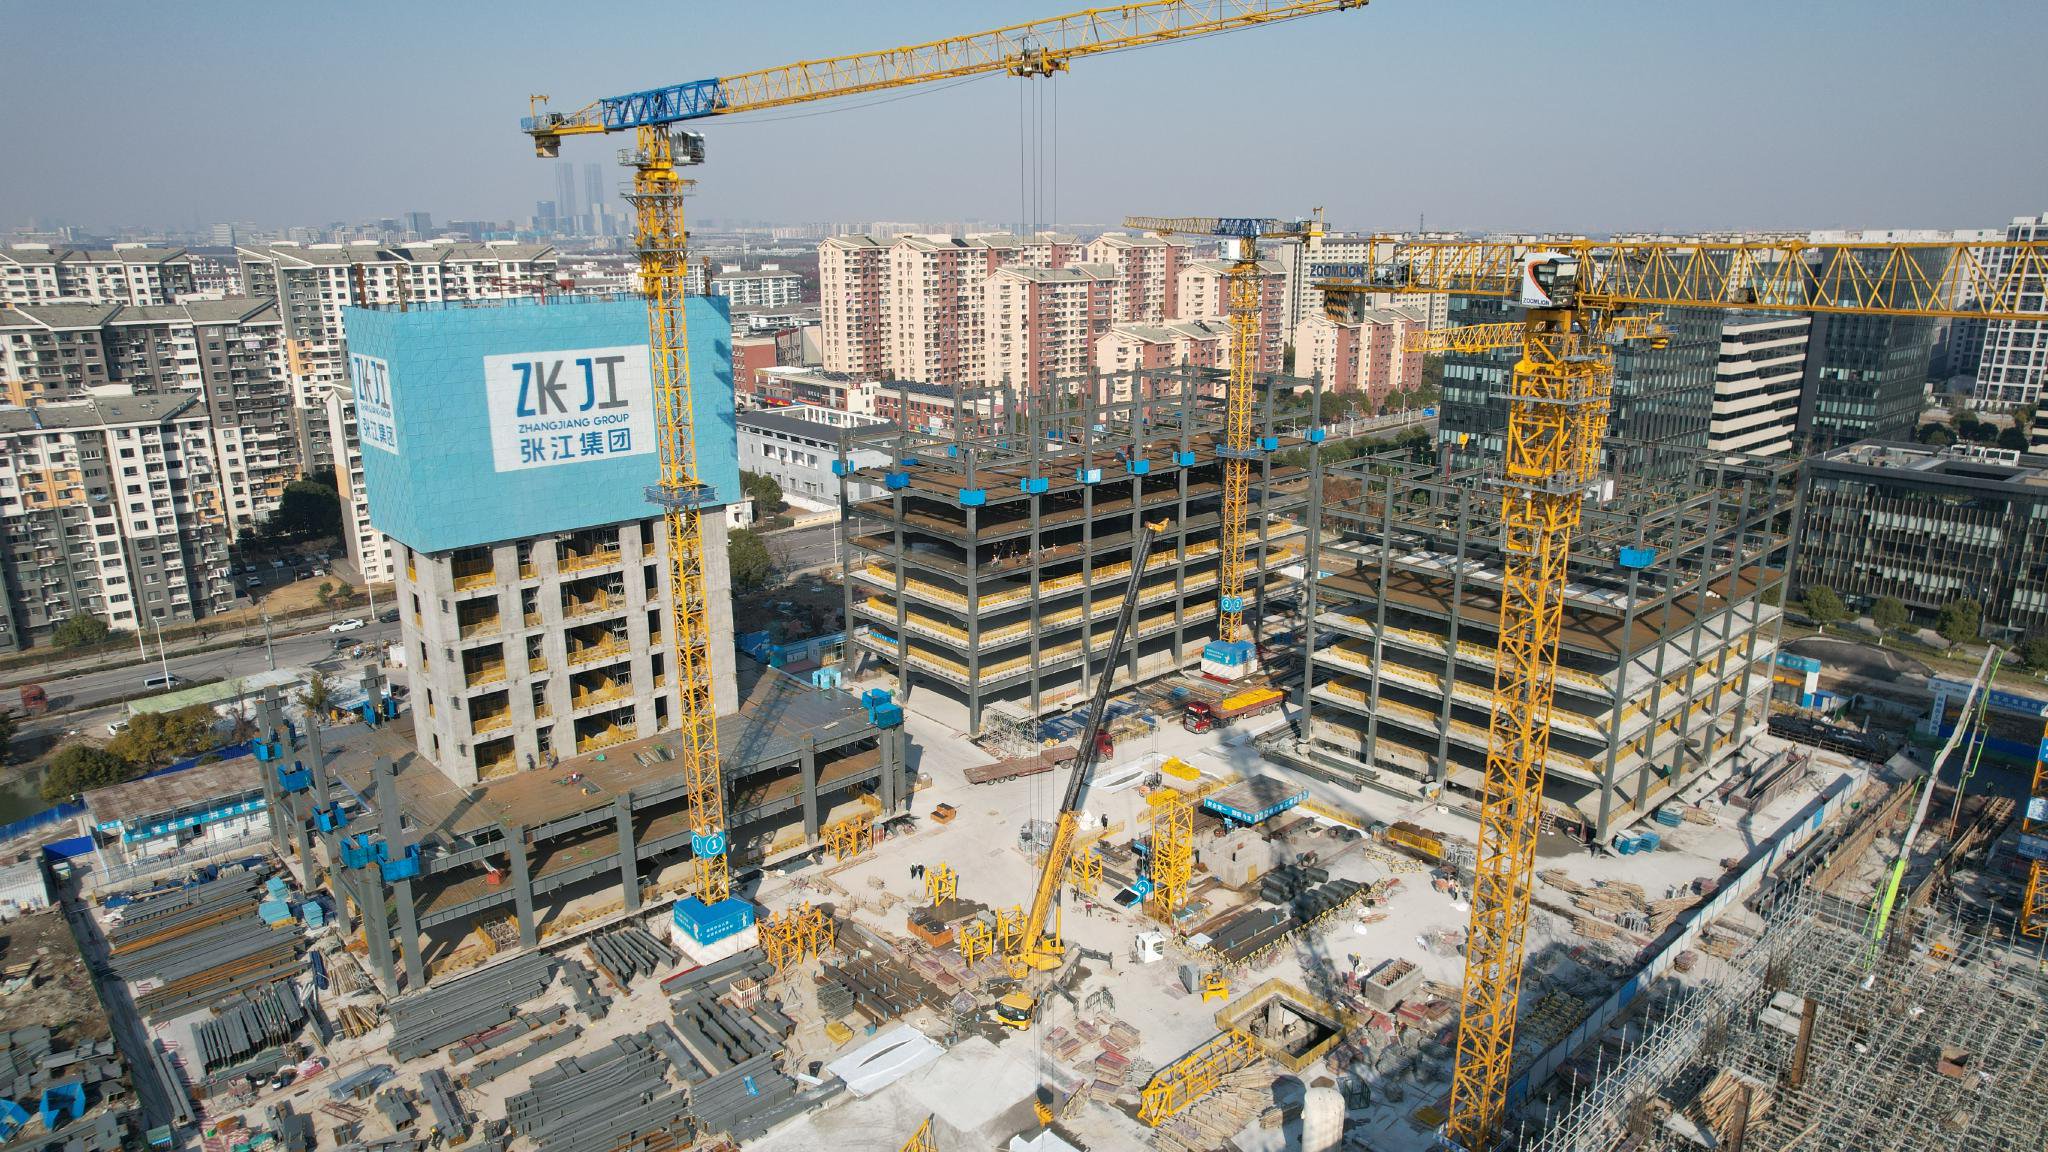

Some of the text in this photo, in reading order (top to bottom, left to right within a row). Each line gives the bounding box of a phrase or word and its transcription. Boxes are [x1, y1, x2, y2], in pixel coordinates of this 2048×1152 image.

[1310, 265, 1364, 278] ZOOMLION
[518, 413, 630, 434] ZHANGJIANG GROUP
[520, 428, 632, 463] 张江集团
